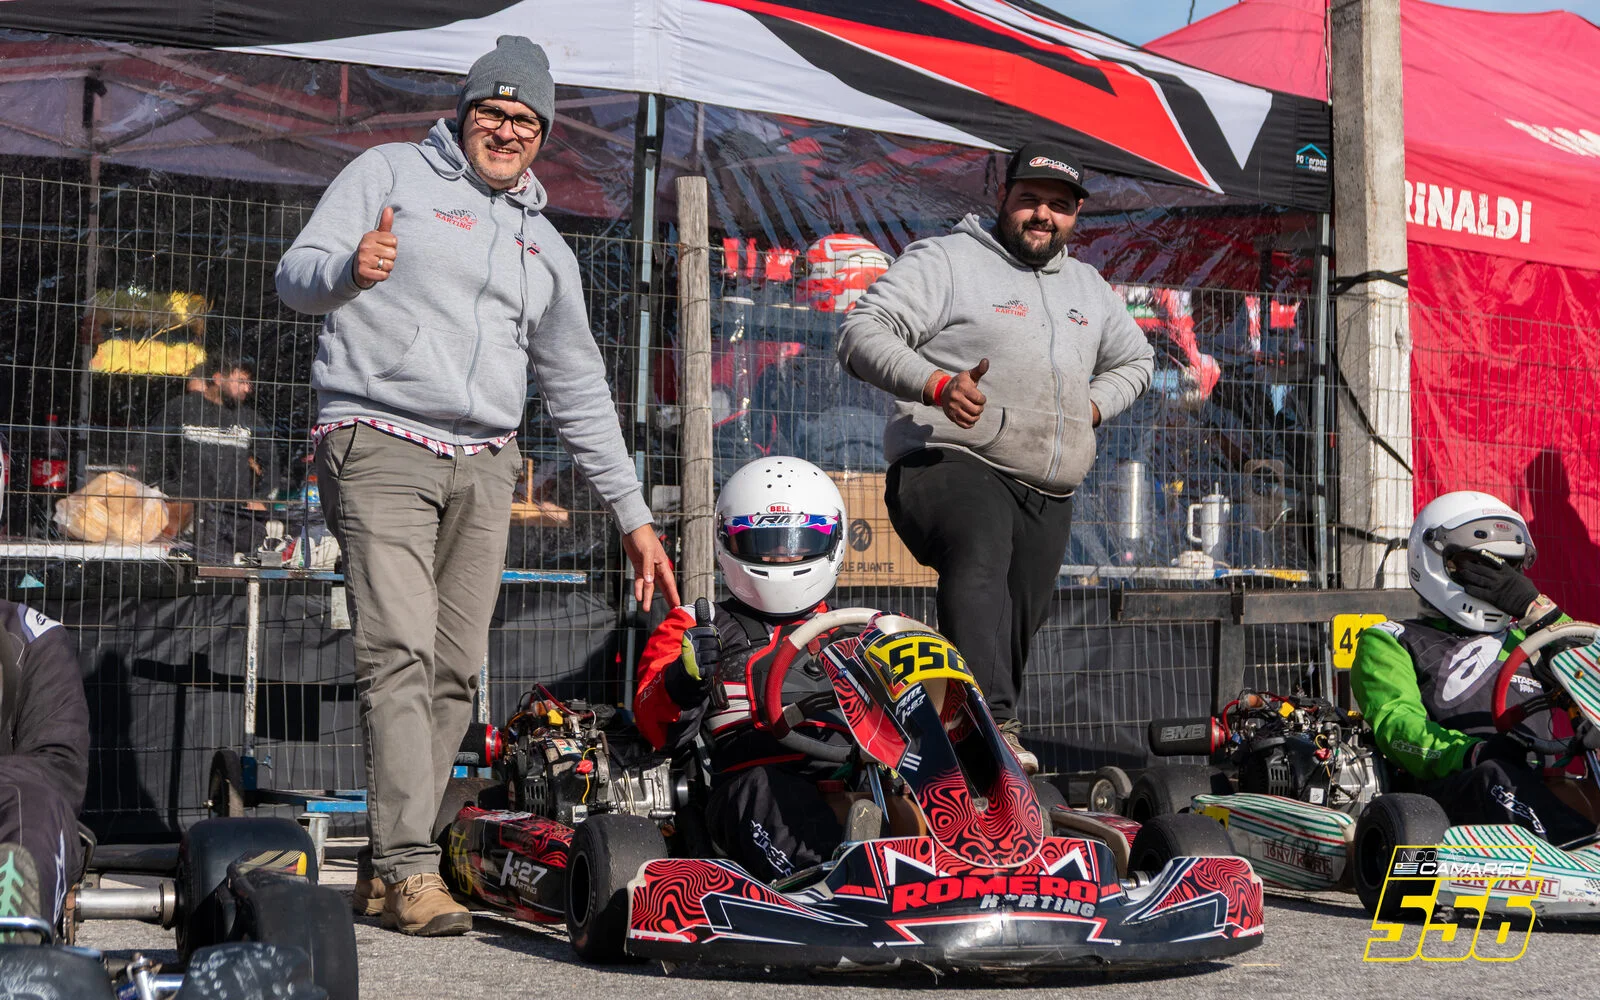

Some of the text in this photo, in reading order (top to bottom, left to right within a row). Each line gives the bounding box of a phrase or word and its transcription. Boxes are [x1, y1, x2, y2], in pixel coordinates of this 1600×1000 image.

[498, 85, 516, 97] CAT
[435, 212, 472, 231] KARTING
[995, 307, 1026, 318] KARTING
[770, 505, 792, 513] BELL
[857, 563, 894, 573] PLIANTE
[888, 641, 973, 688] 556
[1160, 724, 1206, 742] BMB
[892, 875, 1098, 914] ROMERO
